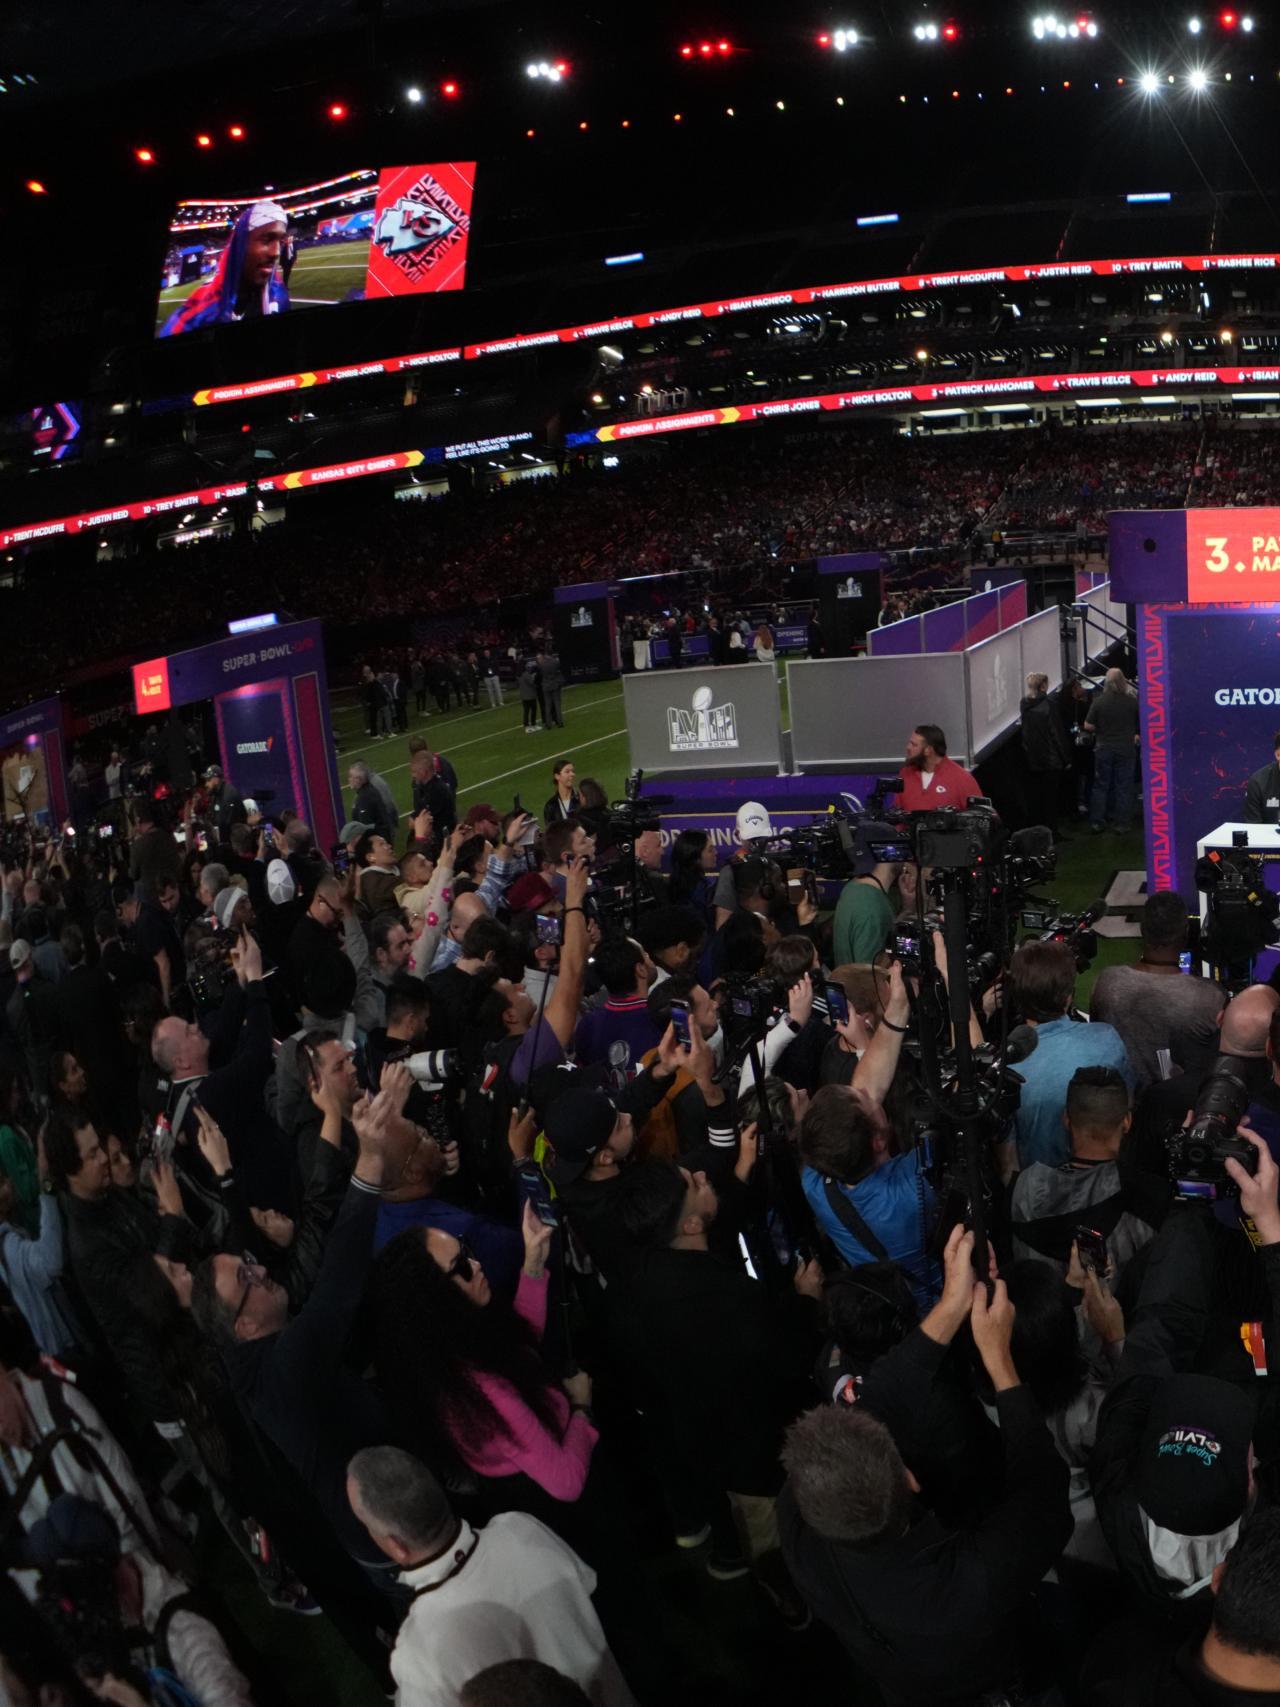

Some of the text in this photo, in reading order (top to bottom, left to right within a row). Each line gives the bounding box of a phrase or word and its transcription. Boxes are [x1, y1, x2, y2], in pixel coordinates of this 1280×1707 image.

[1067, 377, 1100, 387] TRAVIS
[1101, 375, 1130, 385] KELCE
[1166, 373, 1196, 382] ANDY
[1196, 372, 1217, 382] REID
[1252, 371, 1279, 380] ISIAH
[945, 384, 983, 395] PATRICK
[984, 381, 1034, 392] MAHOMES
[852, 394, 874, 404] NICK
[875, 391, 911, 402] BOLTON
[763, 404, 791, 415] CHRIS
[791, 400, 820, 411] JONES
[620, 414, 715, 435] PODIUM ASSIGNMENTS
[222, 653, 256, 673] SUPER
[260, 644, 293, 661] BOWL
[236, 741, 268, 754] GATORADE
